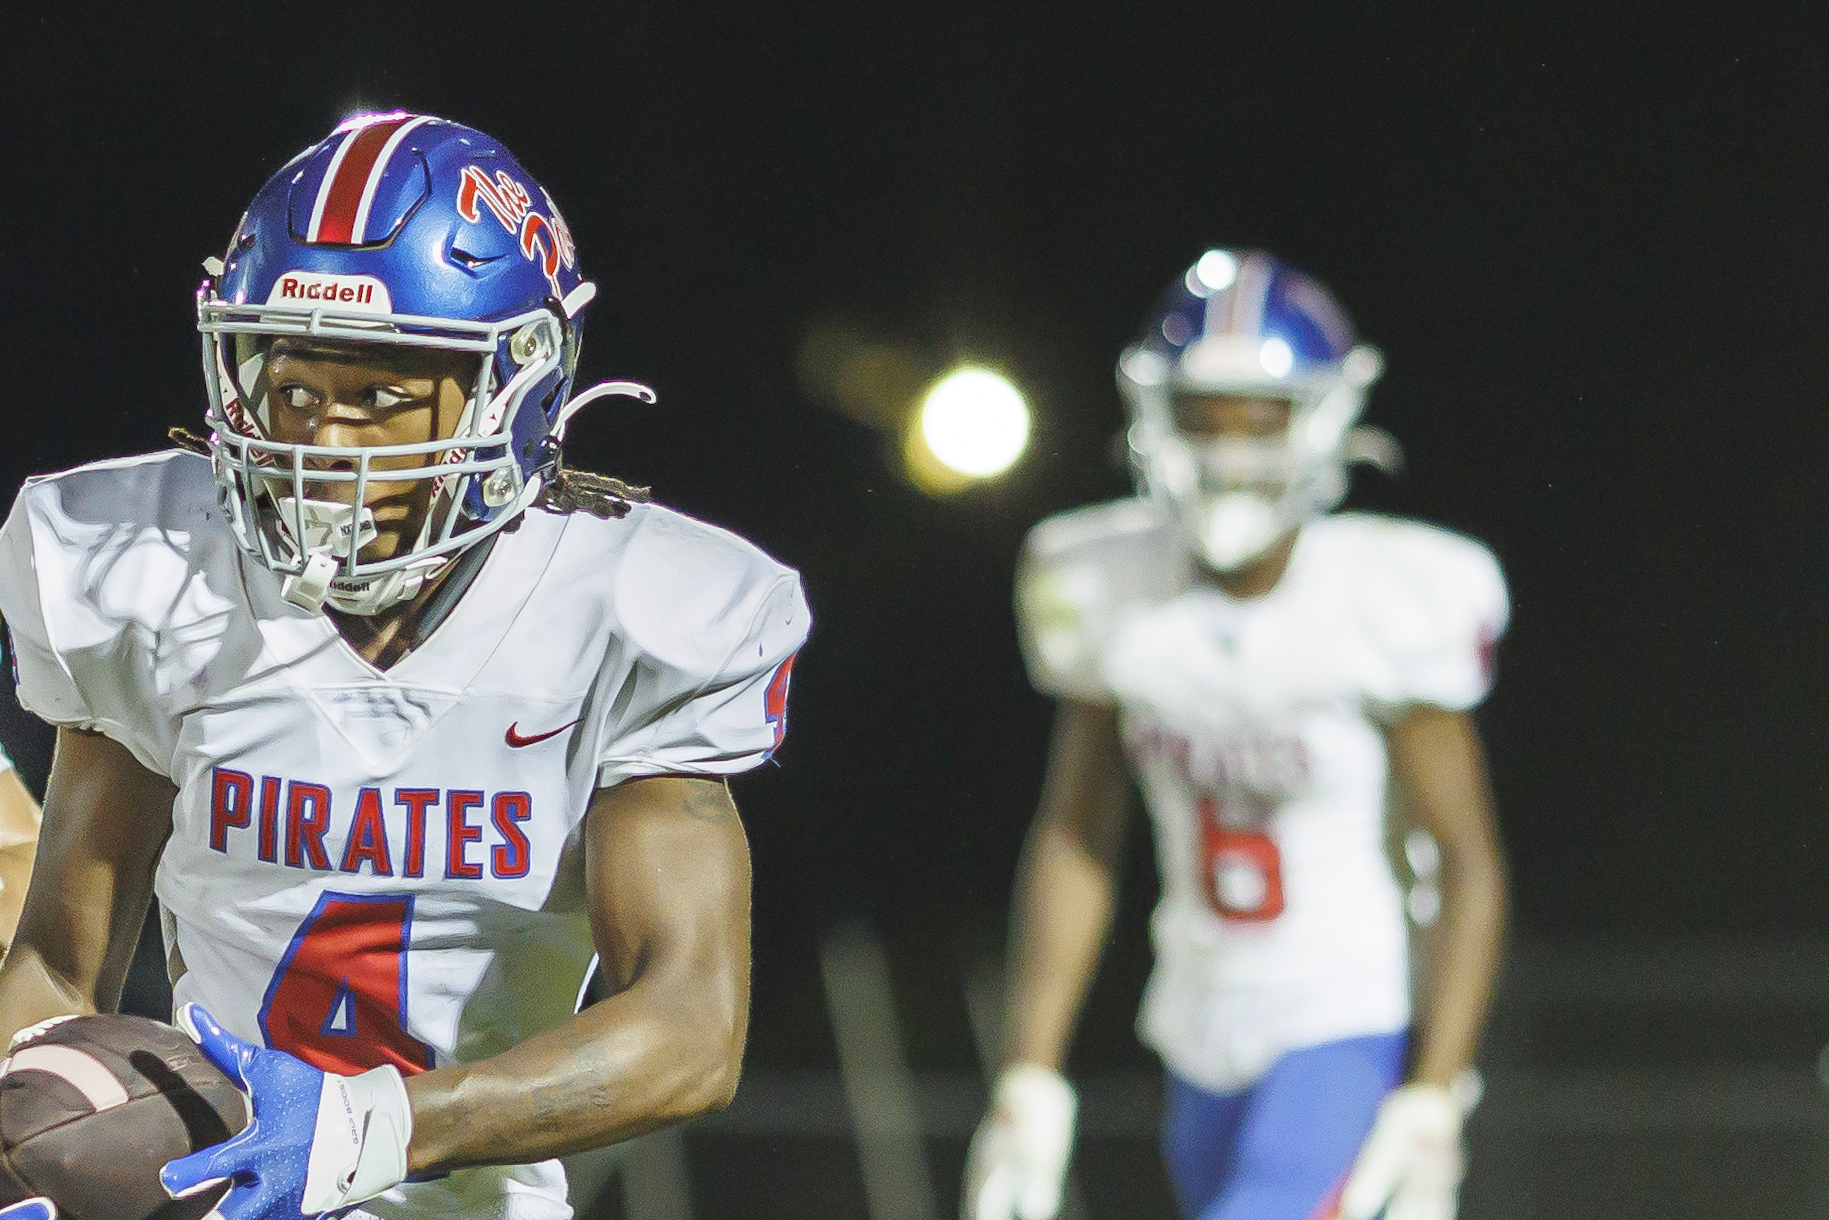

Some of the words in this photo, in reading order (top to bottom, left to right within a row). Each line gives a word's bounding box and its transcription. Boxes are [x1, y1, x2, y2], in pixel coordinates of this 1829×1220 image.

[281, 278, 374, 304] Riddell
[209, 766, 532, 880] PIRATES
[257, 889, 437, 1078] 4
